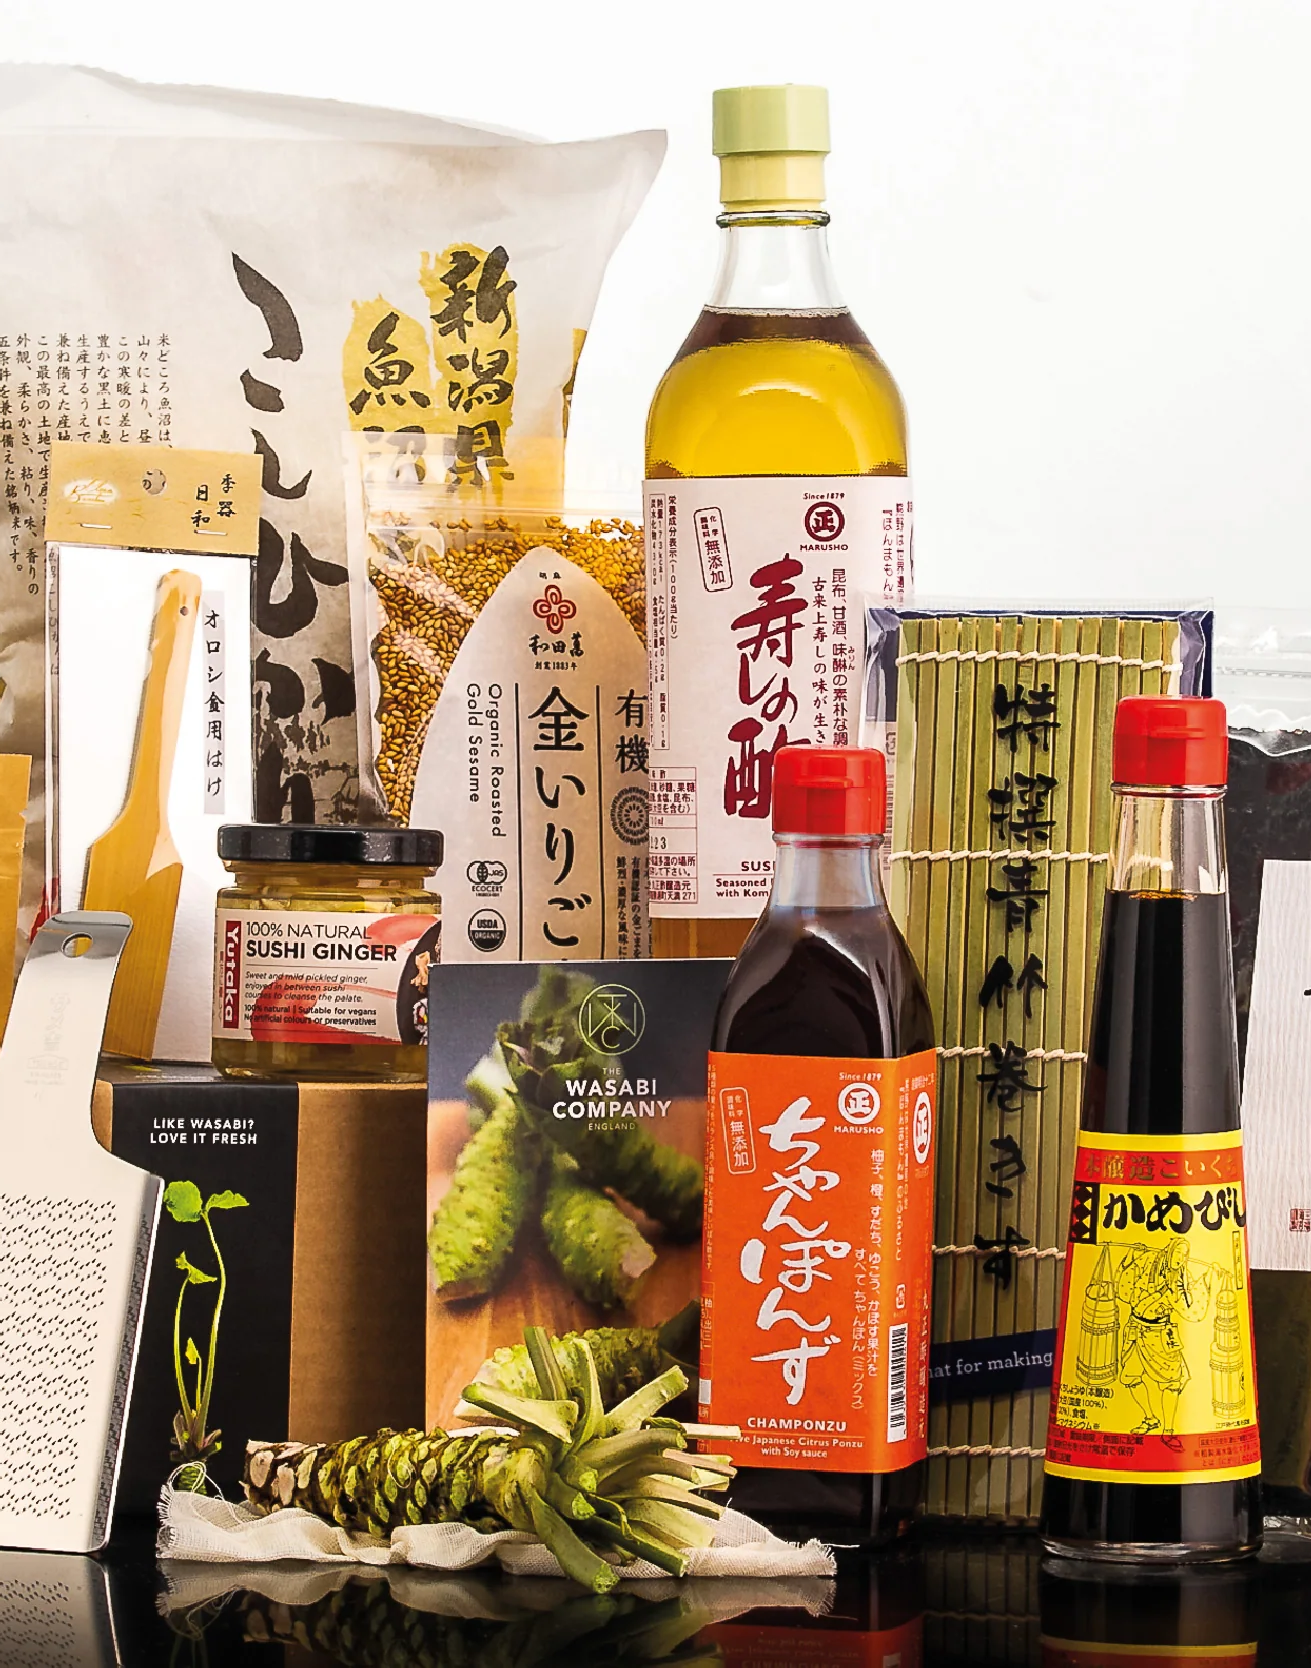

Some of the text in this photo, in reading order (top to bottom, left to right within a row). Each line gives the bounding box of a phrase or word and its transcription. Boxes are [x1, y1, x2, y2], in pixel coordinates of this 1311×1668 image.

[76, 333, 91, 443] 生産するうえで
[117, 335, 132, 442] この寒暖の差と
[158, 333, 173, 449] 米どころ魚沼は、
[803, 492, 825, 500] Since
[799, 544, 849, 552] MARUSHO
[704, 540, 726, 585] 無添加
[466, 683, 481, 803] Gold Sesame
[486, 683, 506, 838] Organic Roasted
[741, 861, 775, 872] SUS
[472, 885, 503, 893] ECOCERT
[716, 878, 767, 887] Seasoned
[716, 889, 740, 897] with
[246, 921, 372, 940] 100% NATURAL
[476, 919, 498, 929] USDA
[474, 932, 501, 940] ORGANIC
[246, 940, 397, 961] SUSHI GINGER
[224, 926, 240, 1023] Yutaka
[245, 971, 368, 985] Sweet and mild pickled ginger,
[245, 982, 272, 991] enjoyed
[284, 983, 321, 991] between
[323, 984, 345, 992] sushi
[284, 992, 317, 1001] cleanse
[318, 993, 332, 1001] the
[263, 1005, 290, 1013] natural
[298, 1006, 331, 1015] Suitable
[334, 1007, 345, 1015] for
[348, 1009, 376, 1017] vegans
[324, 1017, 376, 1026] preservatives
[602, 1067, 621, 1075] THE
[839, 1072, 882, 1082] Since 1879
[566, 1079, 657, 1097] WASABI
[848, 1090, 871, 1113] 正
[552, 1101, 672, 1119] COMPANY
[153, 1118, 254, 1130] LIKE WASABI?
[588, 1123, 636, 1131] ENGLAND
[834, 1125, 884, 1134] MARUSHO
[150, 1132, 257, 1145] LOVE IT FRESH
[729, 1120, 749, 1167] 無添加
[1103, 1187, 1247, 1234] かめびし
[740, 1096, 851, 1406] ちゃんぽんず
[956, 1358, 982, 1375] for
[987, 1351, 1054, 1371] making
[747, 1417, 847, 1431] CHAMPONZU
[752, 1435, 795, 1445] Japanese
[798, 1437, 829, 1446] Citrus
[832, 1438, 863, 1448] Ponzu
[761, 1446, 827, 1458] with Soy sauce
